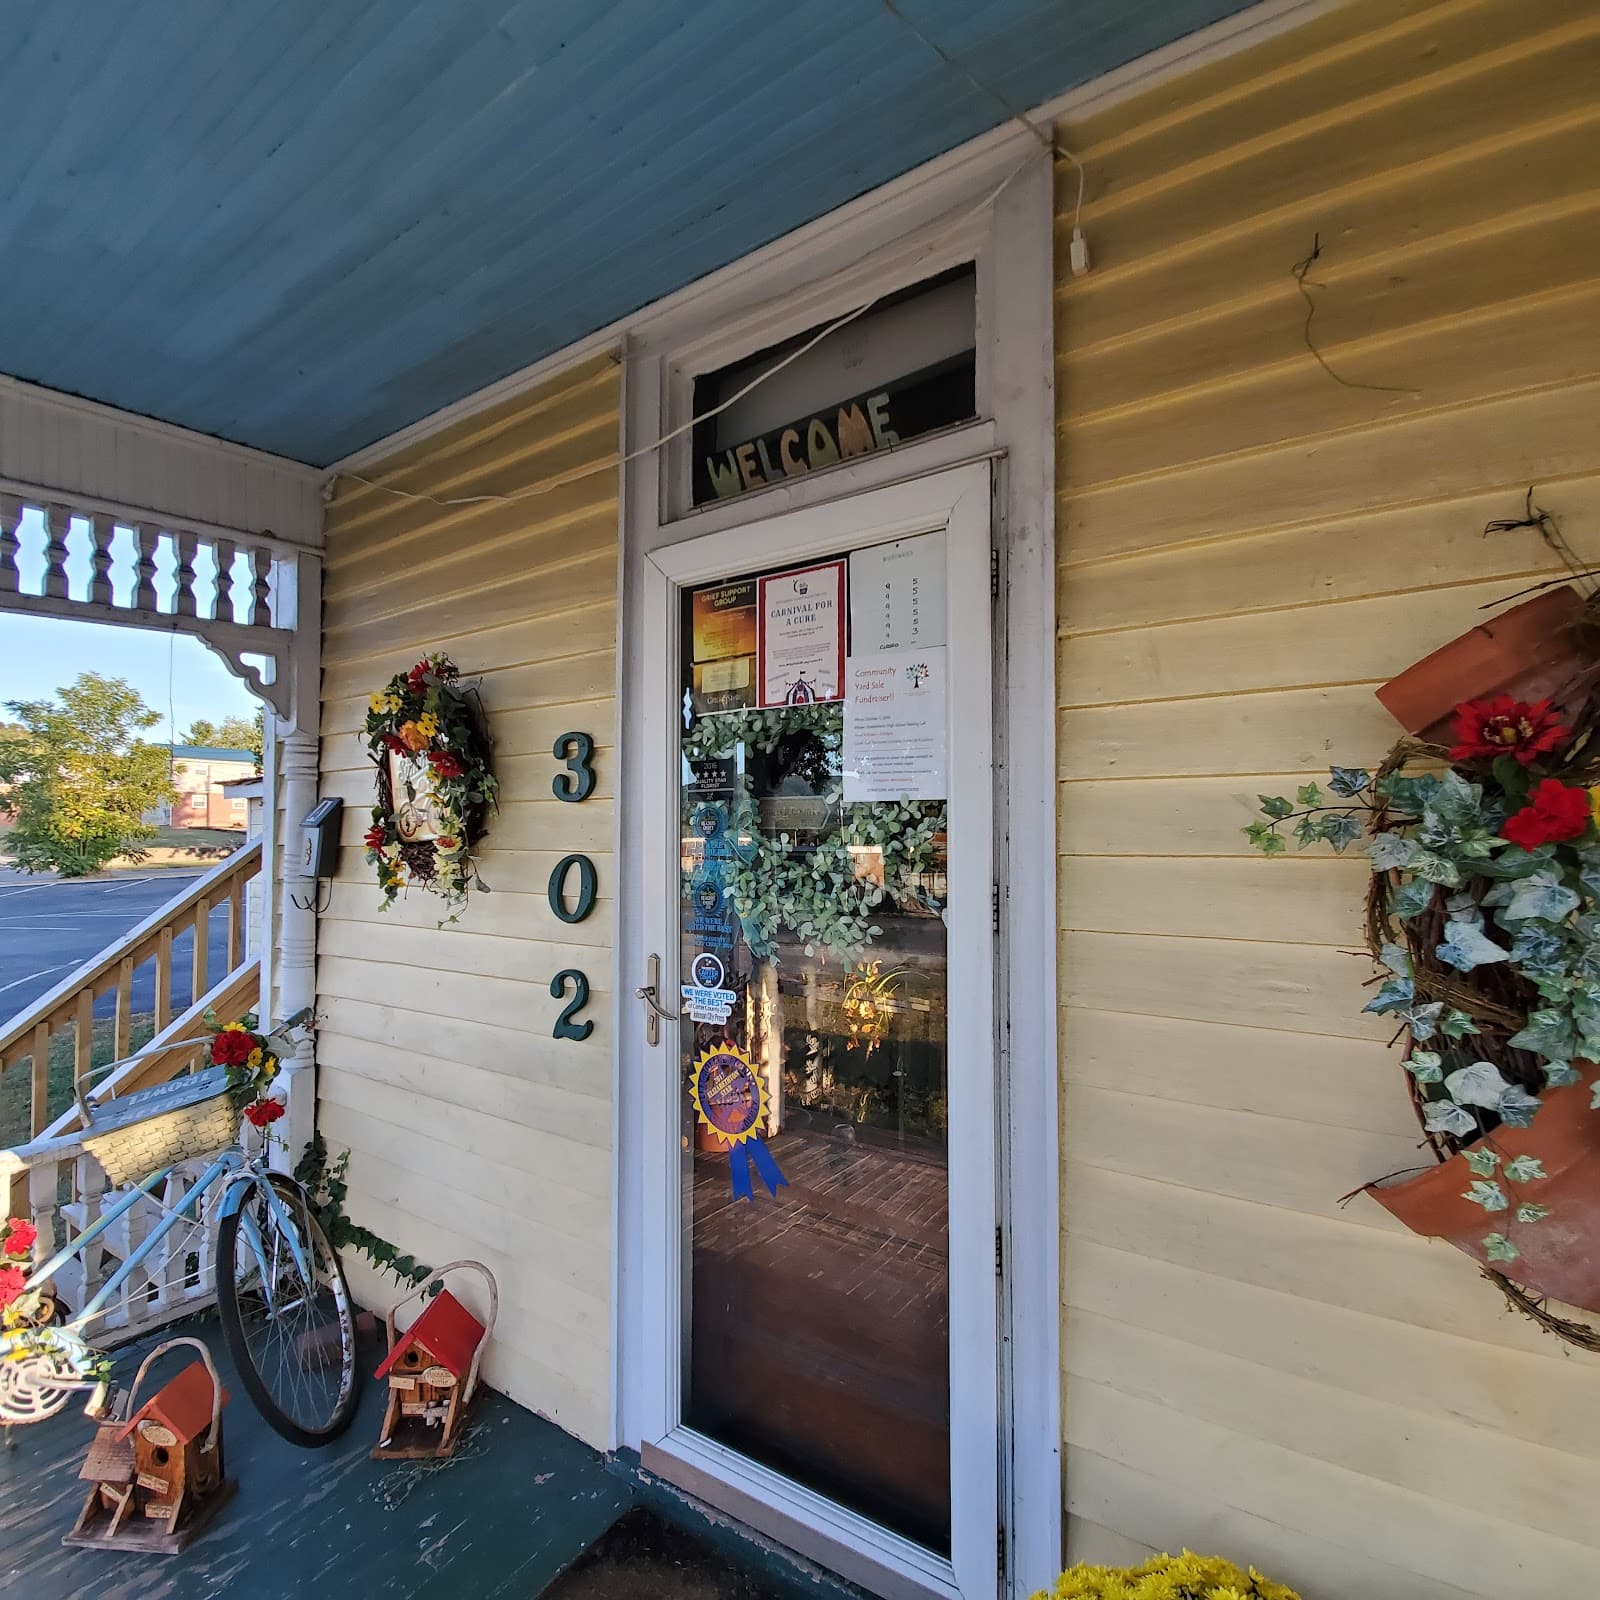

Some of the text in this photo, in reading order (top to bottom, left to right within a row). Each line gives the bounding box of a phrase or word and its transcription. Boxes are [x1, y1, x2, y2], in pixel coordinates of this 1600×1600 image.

[721, 585, 751, 599] SUPPORT
[912, 587, 918, 595] 5
[714, 595, 737, 607] GROUP
[770, 600, 833, 619] CARNIVAL FOR
[785, 614, 817, 627] A CURE
[912, 627, 918, 635] 3
[855, 667, 897, 678] Community
[855, 680, 885, 691] Yard Sale
[684, 987, 735, 1001] WE WERE VOTED
[695, 997, 724, 1007] THE BEST
[713, 1071, 725, 1084] 2017
[719, 1084, 734, 1098] STAR
